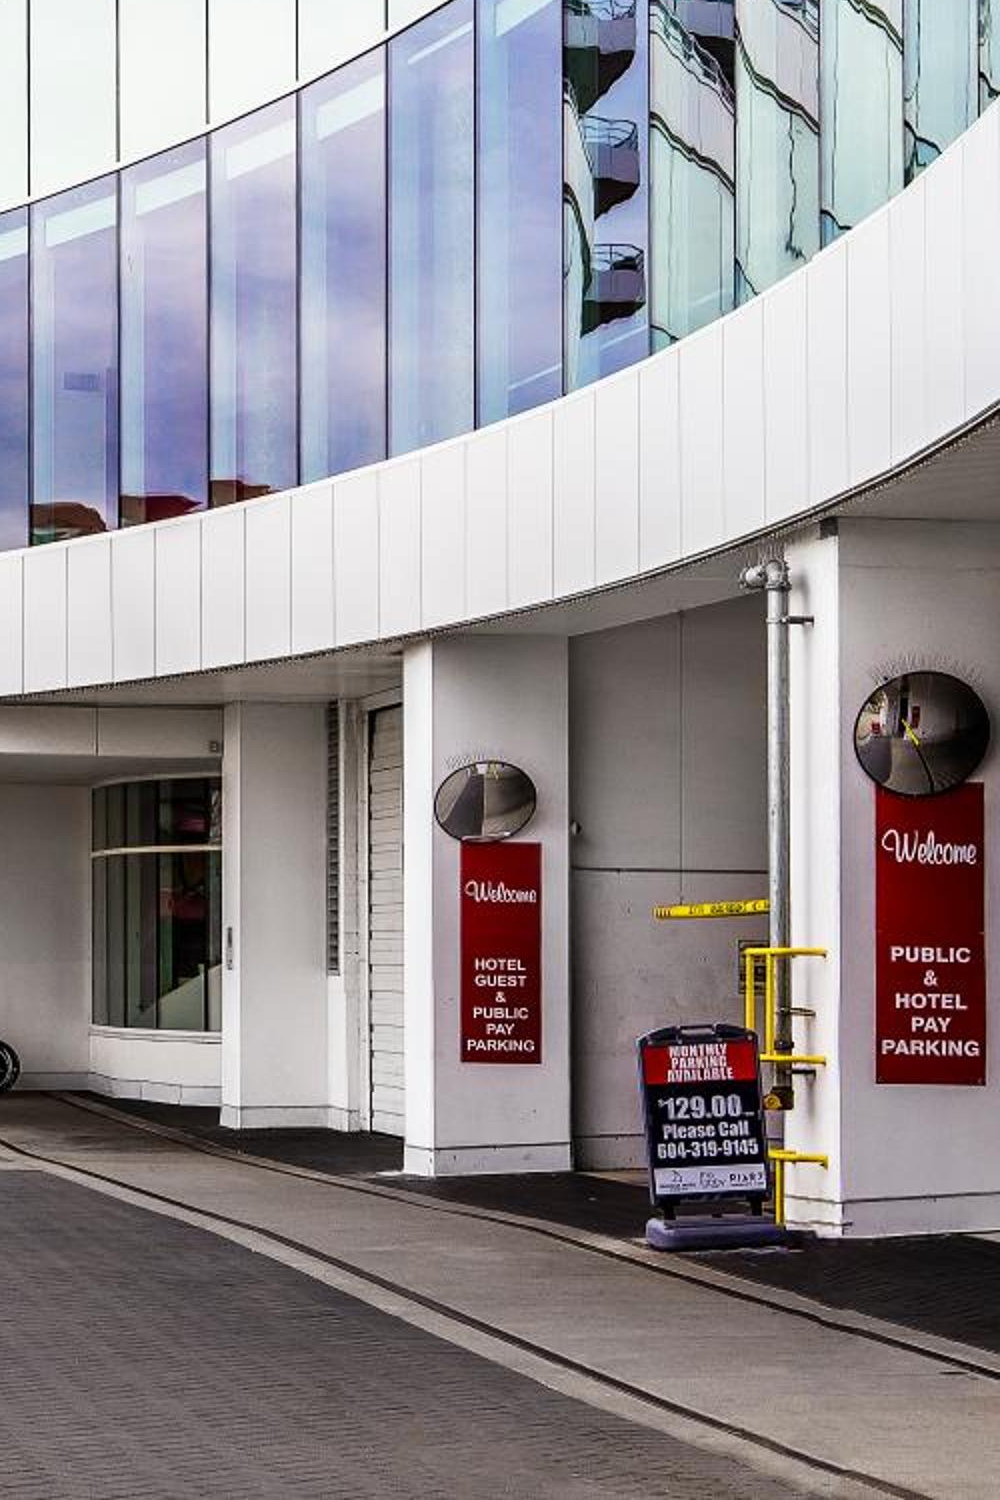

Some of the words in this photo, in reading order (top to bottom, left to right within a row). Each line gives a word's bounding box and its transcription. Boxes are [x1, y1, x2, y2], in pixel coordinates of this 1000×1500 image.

[882, 829, 977, 864] Welcome
[464, 880, 537, 903] Welcome
[890, 946, 971, 963] PUBLIC
[474, 958, 526, 971] HOTEL
[474, 975, 527, 987] GUEST
[923, 970, 938, 986] &
[495, 991, 506, 1003] &
[895, 993, 968, 1010] HOTEL
[473, 1007, 529, 1019] PUBLIC
[486, 1023, 515, 1035] PAY
[911, 1016, 952, 1033] PAY
[467, 1039, 535, 1052] PARKING
[668, 1043, 728, 1059] MONTHLY
[881, 1040, 980, 1057] PARKING
[671, 1055, 727, 1070] PARKING
[667, 1067, 734, 1083] AVAILABLE
[663, 1123, 716, 1140] Please
[718, 1121, 750, 1137] Call
[657, 1138, 759, 1159] 604-319-9145
